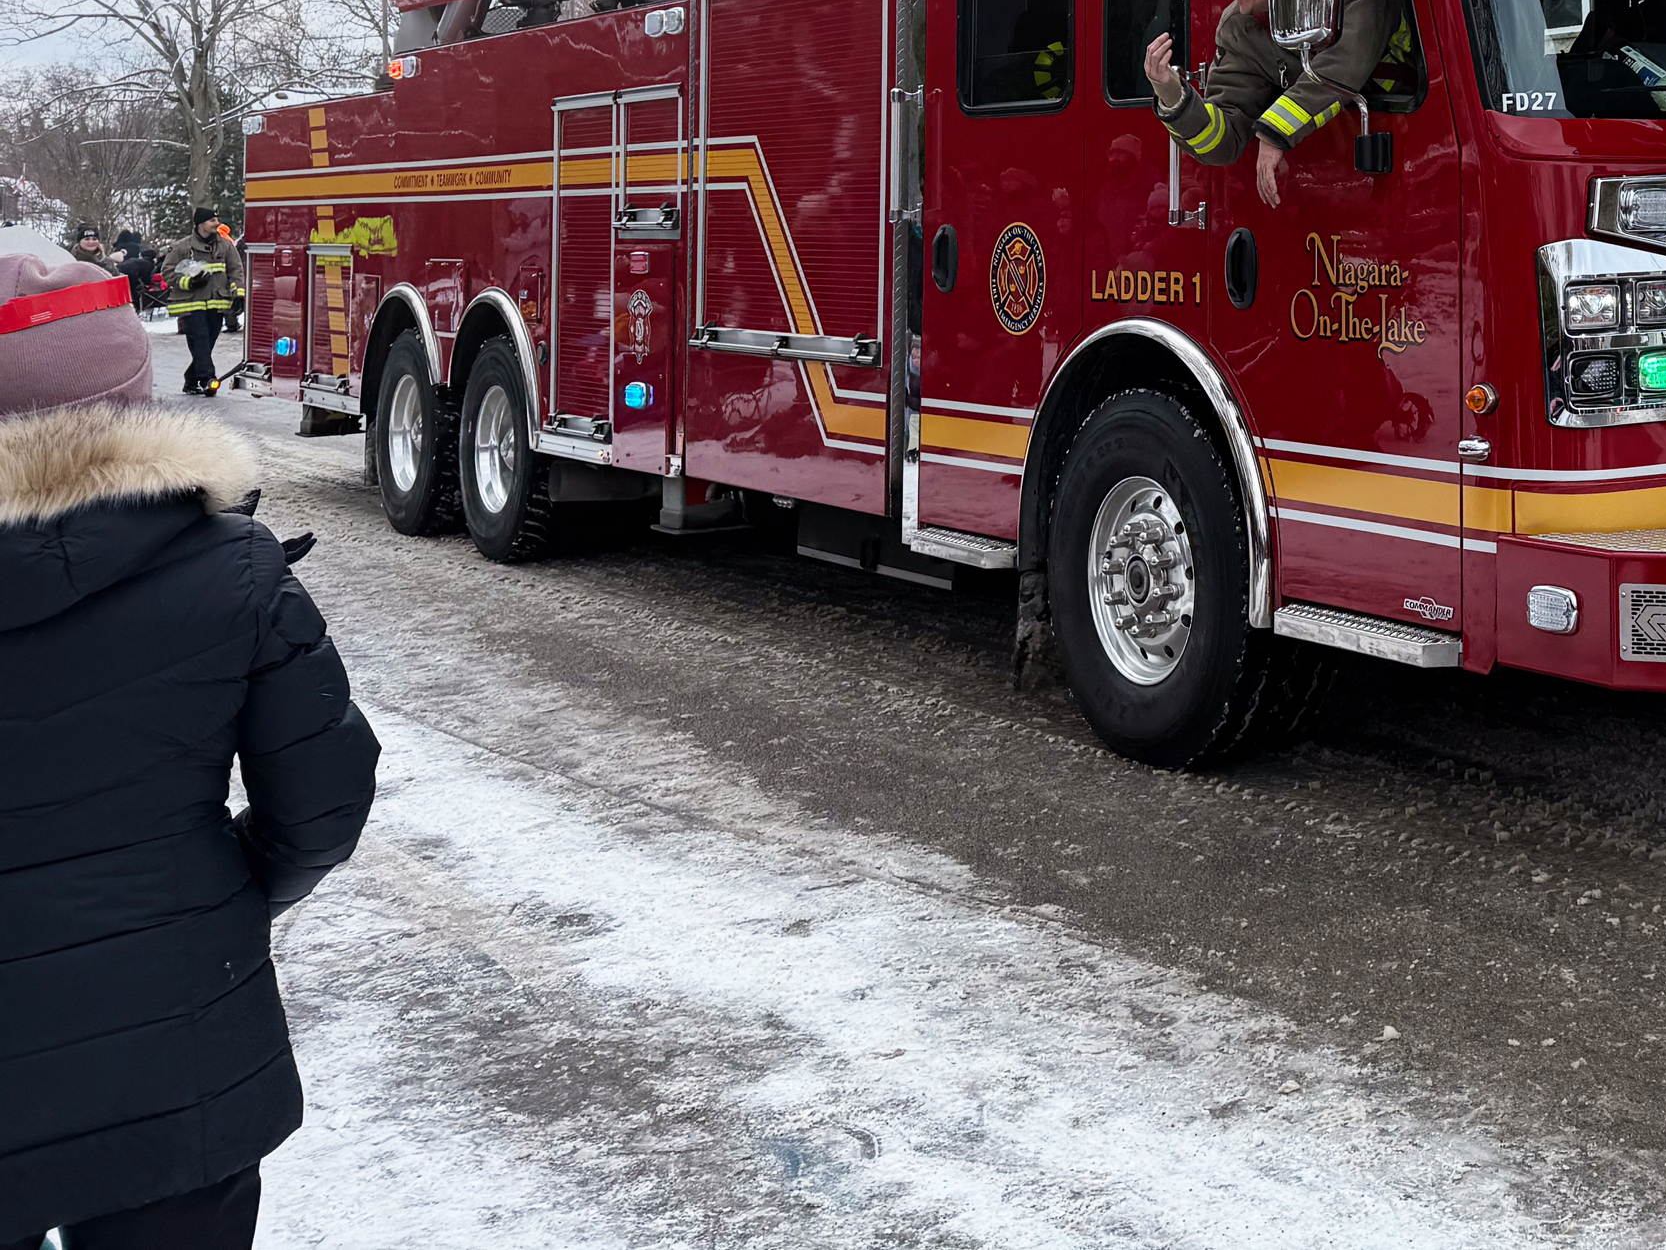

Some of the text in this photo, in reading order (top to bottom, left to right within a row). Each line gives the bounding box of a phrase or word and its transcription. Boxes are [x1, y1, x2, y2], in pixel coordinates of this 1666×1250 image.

[1501, 91, 1557, 113] FD27
[393, 169, 512, 189] COMMITMENT TEAMWORK COMMUNITY
[1306, 232, 1410, 293] Niagara-
[1091, 269, 1201, 304] LADDER 1
[1290, 288, 1428, 359] On-The-Lake
[1404, 599, 1453, 618] COMMANDER
